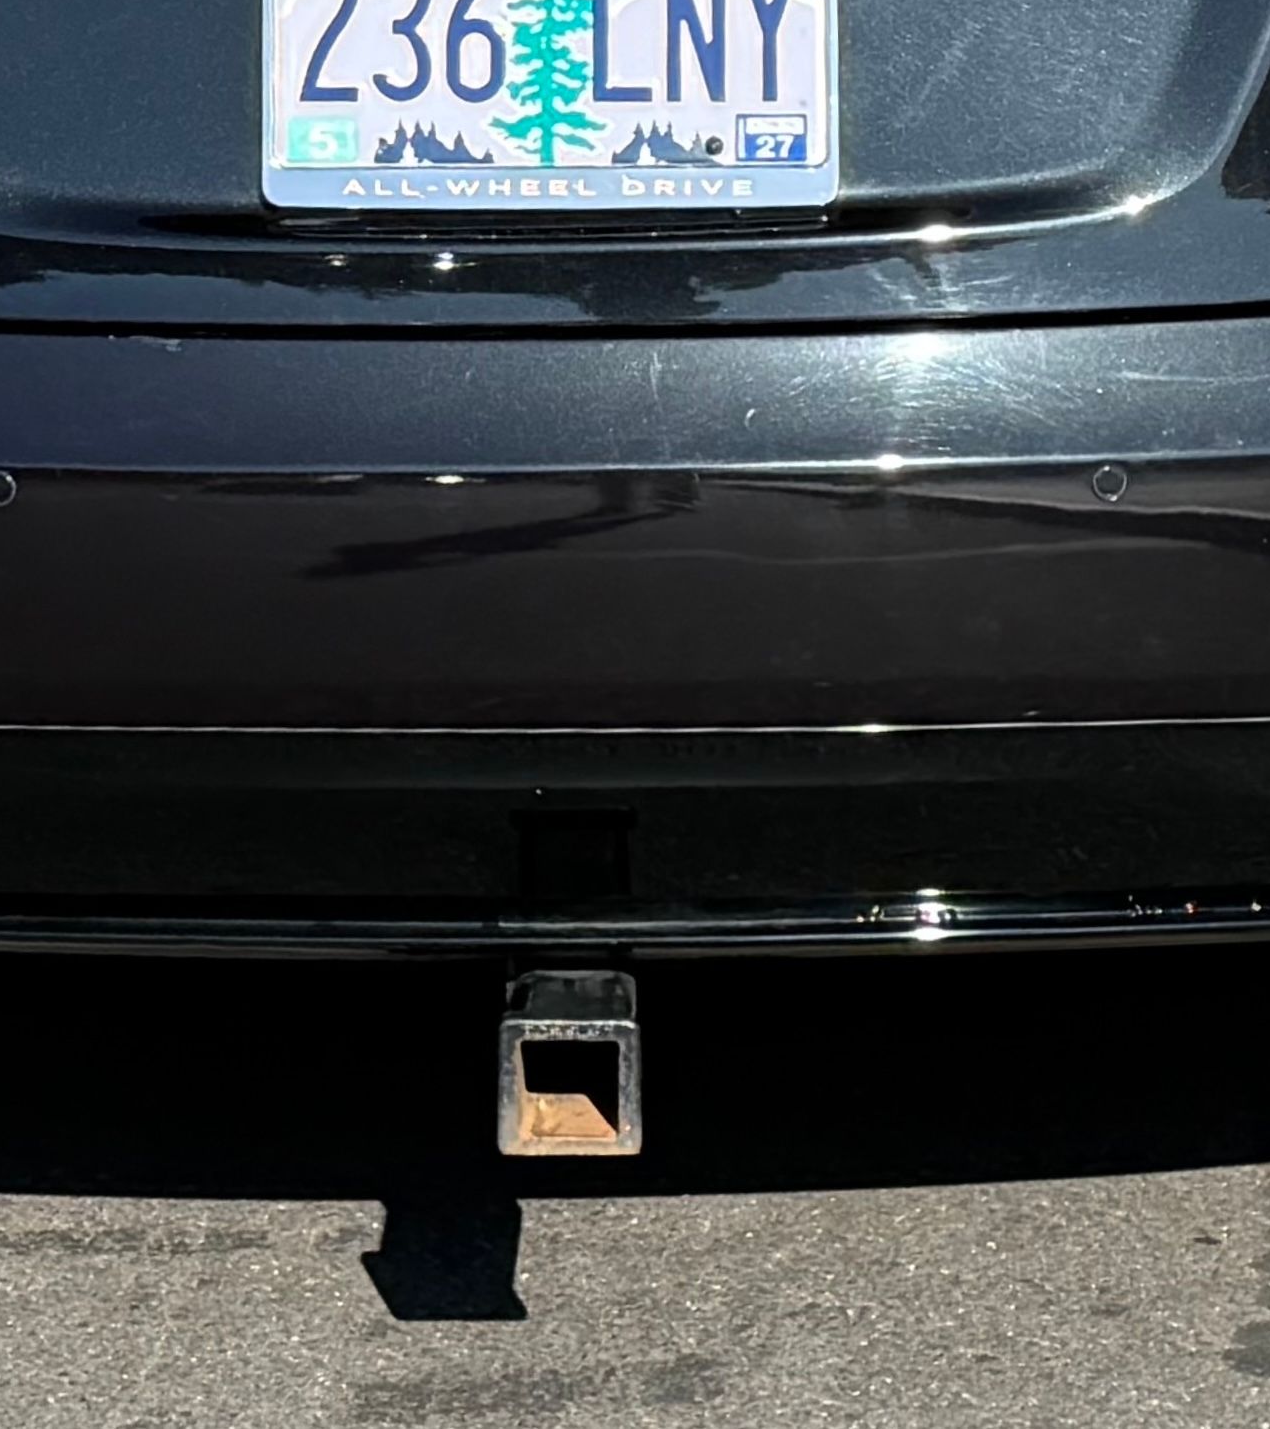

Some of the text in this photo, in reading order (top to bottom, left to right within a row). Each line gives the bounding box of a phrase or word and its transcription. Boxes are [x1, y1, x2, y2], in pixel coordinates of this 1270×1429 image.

[309, 124, 338, 159] 5
[755, 135, 795, 158] 27
[342, 174, 754, 198] ALL-WHEEL DRIVE
